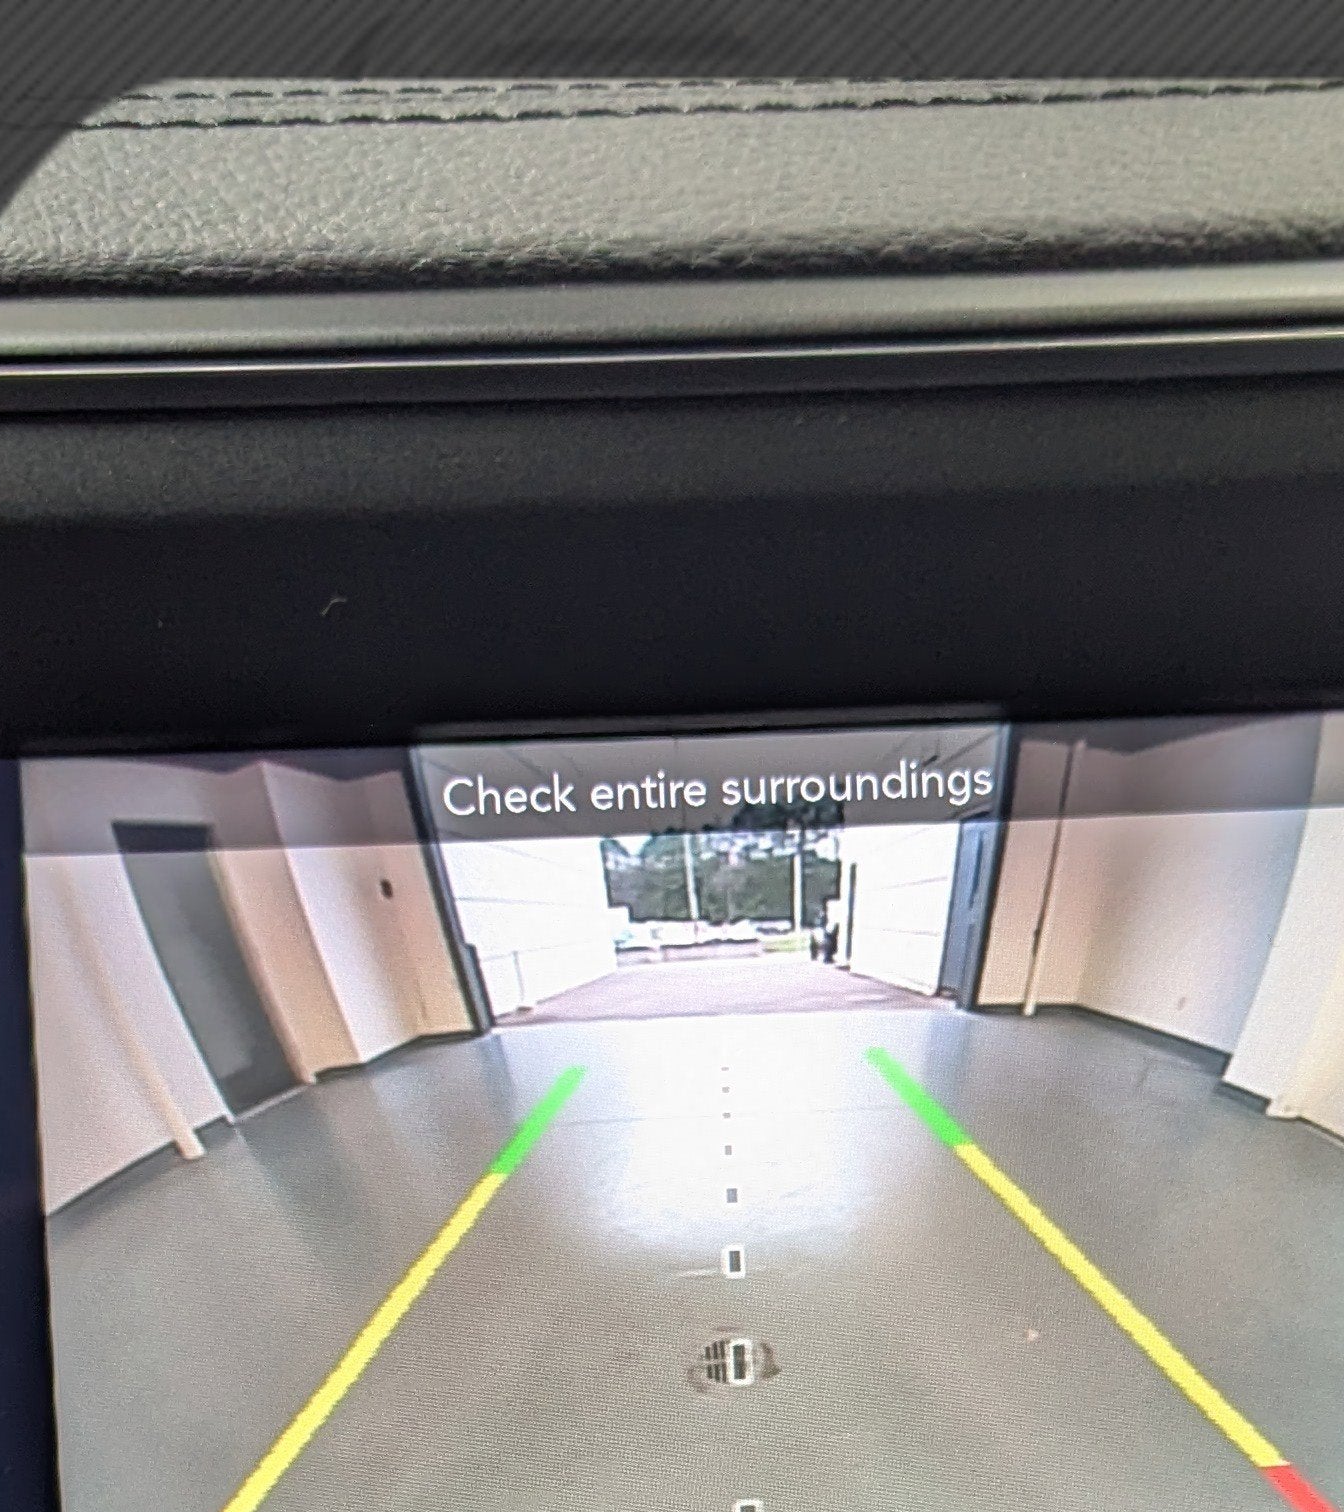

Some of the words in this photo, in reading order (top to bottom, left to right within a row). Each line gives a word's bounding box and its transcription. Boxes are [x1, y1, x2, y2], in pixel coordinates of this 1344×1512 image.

[442, 772, 577, 816] Check
[590, 770, 707, 811] entire
[722, 758, 993, 806] surroundings
